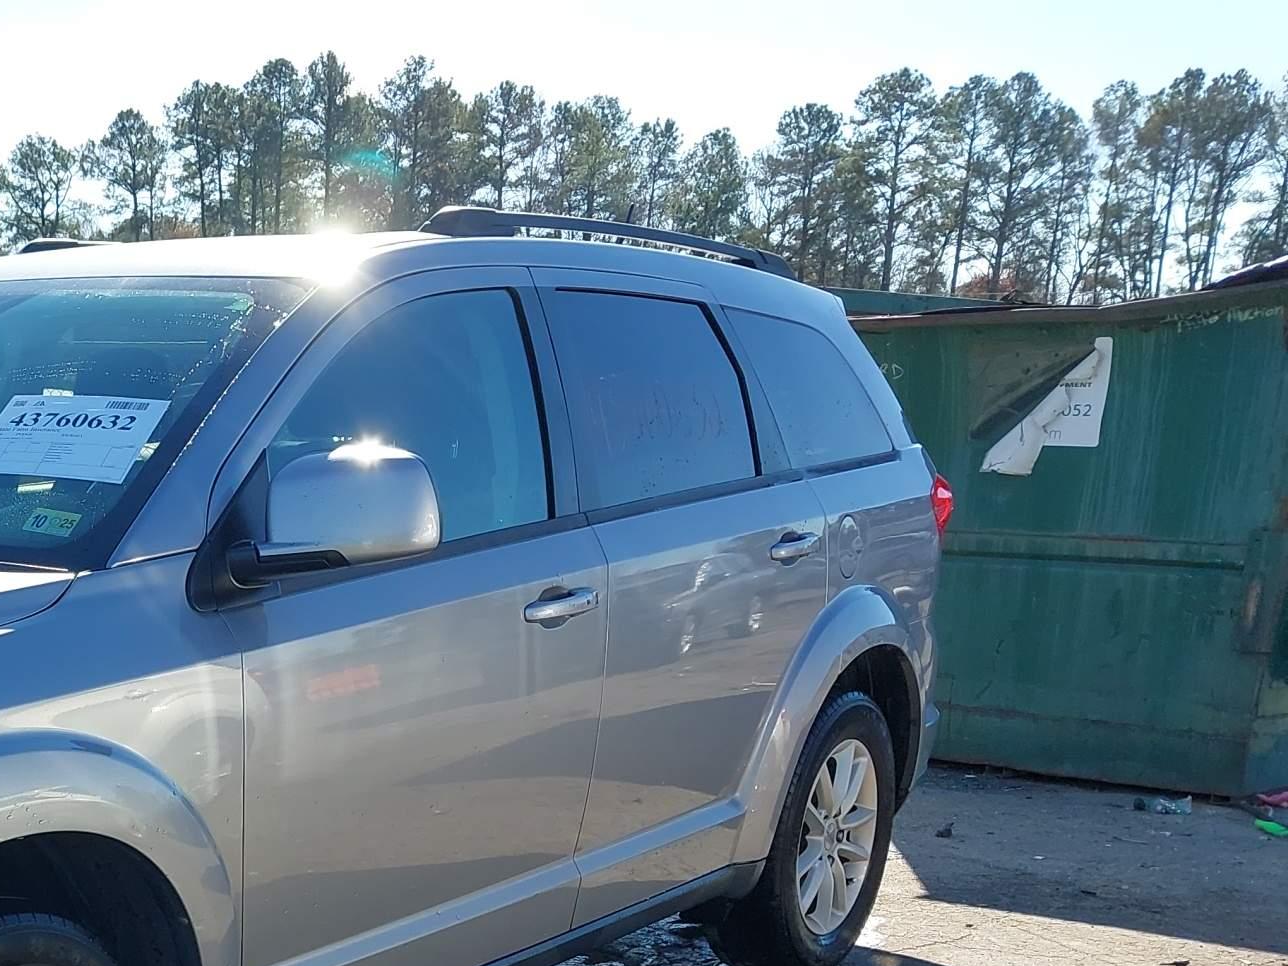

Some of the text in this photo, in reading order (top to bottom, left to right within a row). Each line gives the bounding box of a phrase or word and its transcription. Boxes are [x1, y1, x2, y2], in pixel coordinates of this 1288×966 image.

[9, 412, 137, 431] 43760632
[31, 514, 76, 529] 10 25
